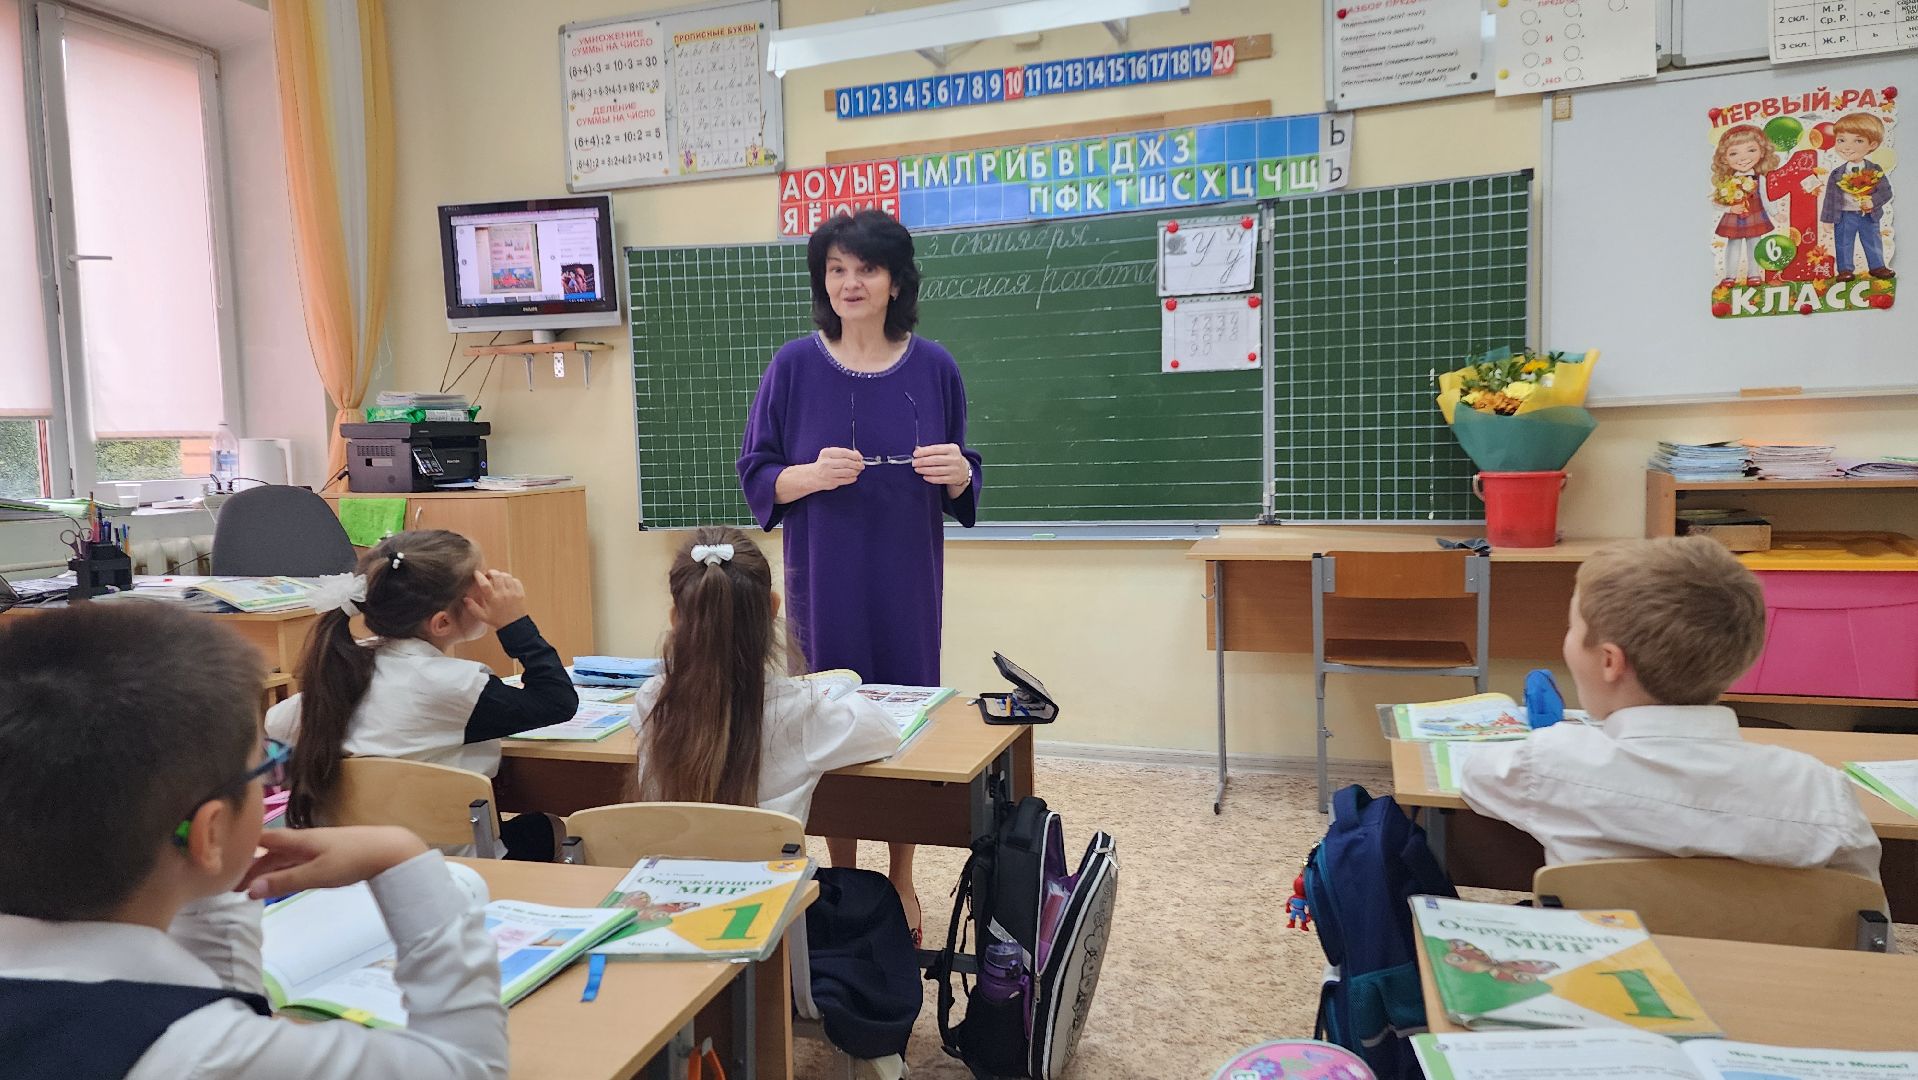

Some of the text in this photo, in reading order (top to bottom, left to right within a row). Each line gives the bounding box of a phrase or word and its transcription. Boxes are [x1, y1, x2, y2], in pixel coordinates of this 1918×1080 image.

[1788, 15, 1809, 23] скл.
[579, 29, 644, 45] УМНОЖЕНИЕ
[673, 23, 756, 44] ПРОПИСНЫЕ БУКВЫ
[572, 38, 653, 56] СУММЫ НА ЧИСЛО
[646, 56, 658, 67] 30
[839, 44, 1234, 115] 0 1 2 3 4 5 6 7 8 9 10 11 12 13 14 15 16 17 18 19 20
[576, 108, 656, 127] СУММЫ НА ЧИСЛО
[593, 102, 637, 115] ДЕЛЕНИЕ
[1711, 87, 1831, 128] ПЕРВЫЙ
[655, 127, 661, 139] 5
[658, 151, 663, 161] 5
[782, 120, 1345, 201] А О У Ы Э Н М Л Р Й Б В Г Д Ж З Ь
[783, 207, 799, 235] Я
[808, 202, 822, 235] Ё
[1030, 186, 1048, 213] П
[1055, 183, 1078, 212] Ф
[1086, 181, 1104, 210] К
[1116, 178, 1134, 206] Т
[1140, 175, 1165, 204] Ш
[1172, 172, 1190, 201] С
[1201, 168, 1222, 198] Х
[1231, 166, 1253, 197] Ц
[1263, 163, 1281, 192] Ч
[1290, 159, 1318, 190] Щ
[1326, 158, 1342, 183] Ъ
[1766, 149, 1836, 281] 1
[1191, 231, 1216, 267] У
[1765, 239, 1781, 261] в
[1220, 249, 1245, 284] у
[1731, 281, 1870, 316] КЛАСС
[637, 875, 774, 888] Окружающий
[675, 885, 748, 895] МИР
[704, 902, 763, 941] 1
[1437, 919, 1619, 944] Окружающий
[1505, 936, 1594, 954] МИР
[1596, 969, 1695, 1021] 1
